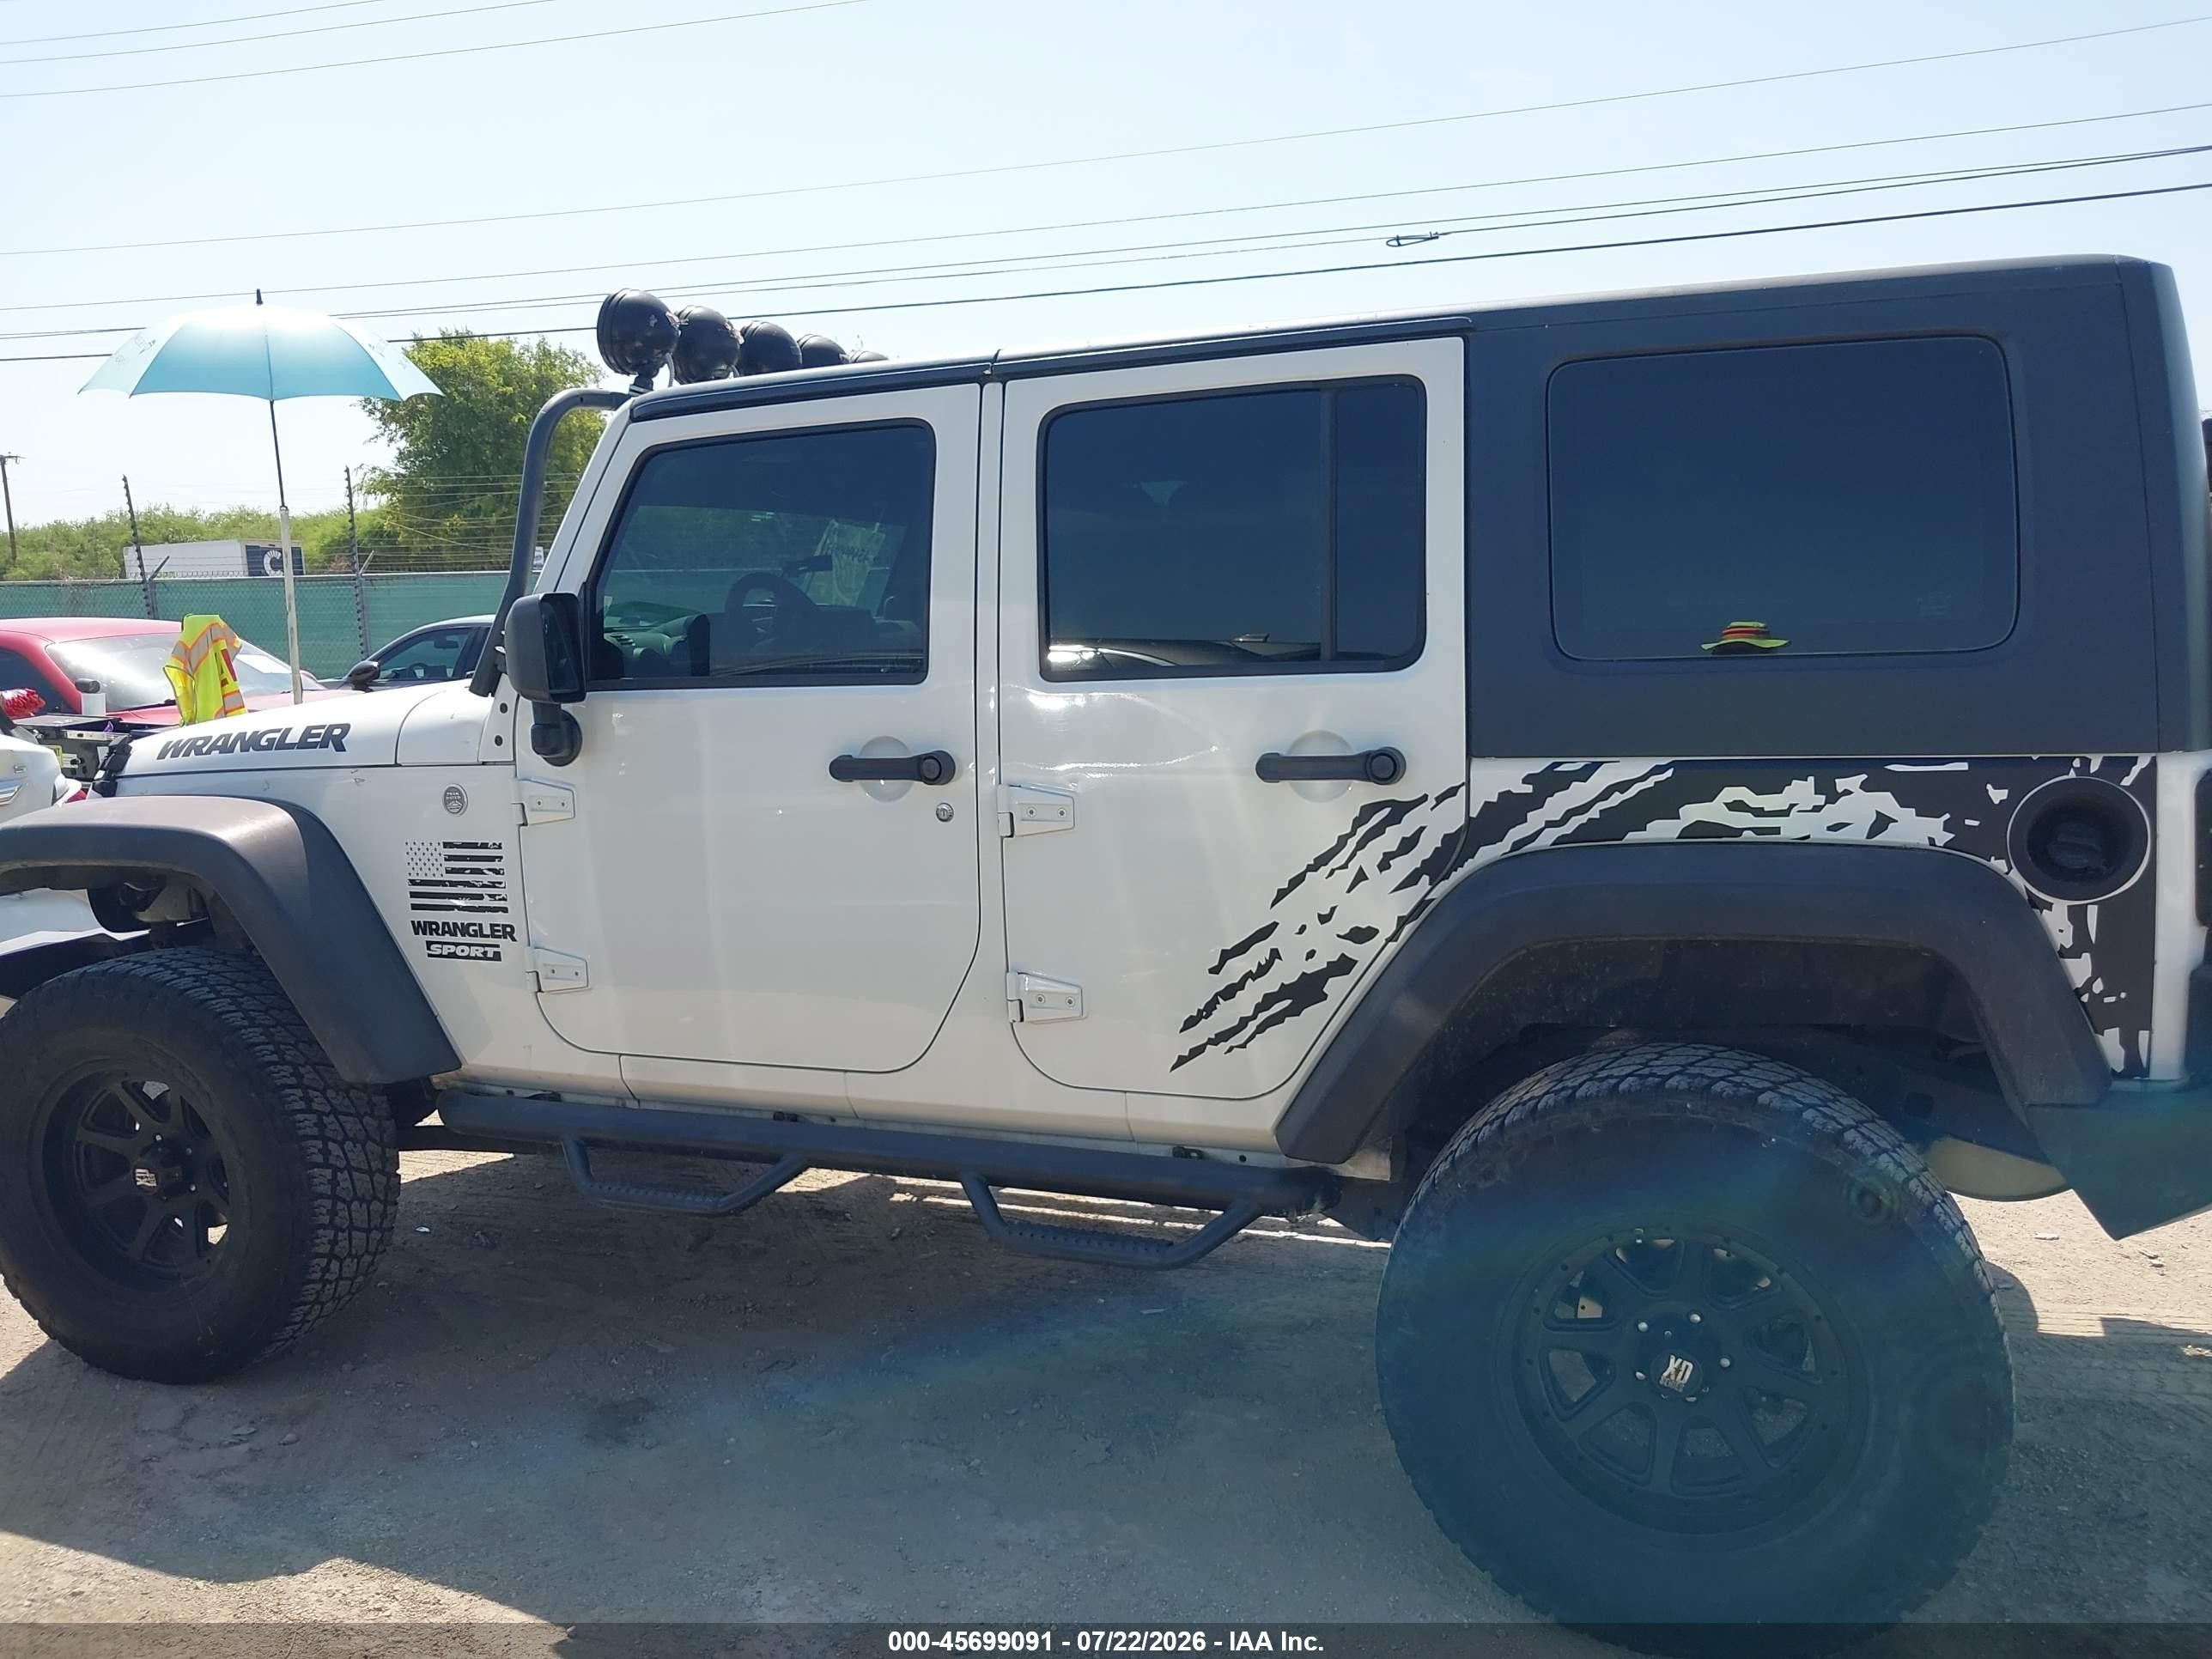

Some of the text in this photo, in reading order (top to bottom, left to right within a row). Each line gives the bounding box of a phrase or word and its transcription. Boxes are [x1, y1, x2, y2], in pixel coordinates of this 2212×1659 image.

[156, 723, 350, 760] WRANGLER
[410, 920, 518, 942] WRANGLER
[428, 944, 500, 958] SPORT
[1662, 1354, 1693, 1383] XD
